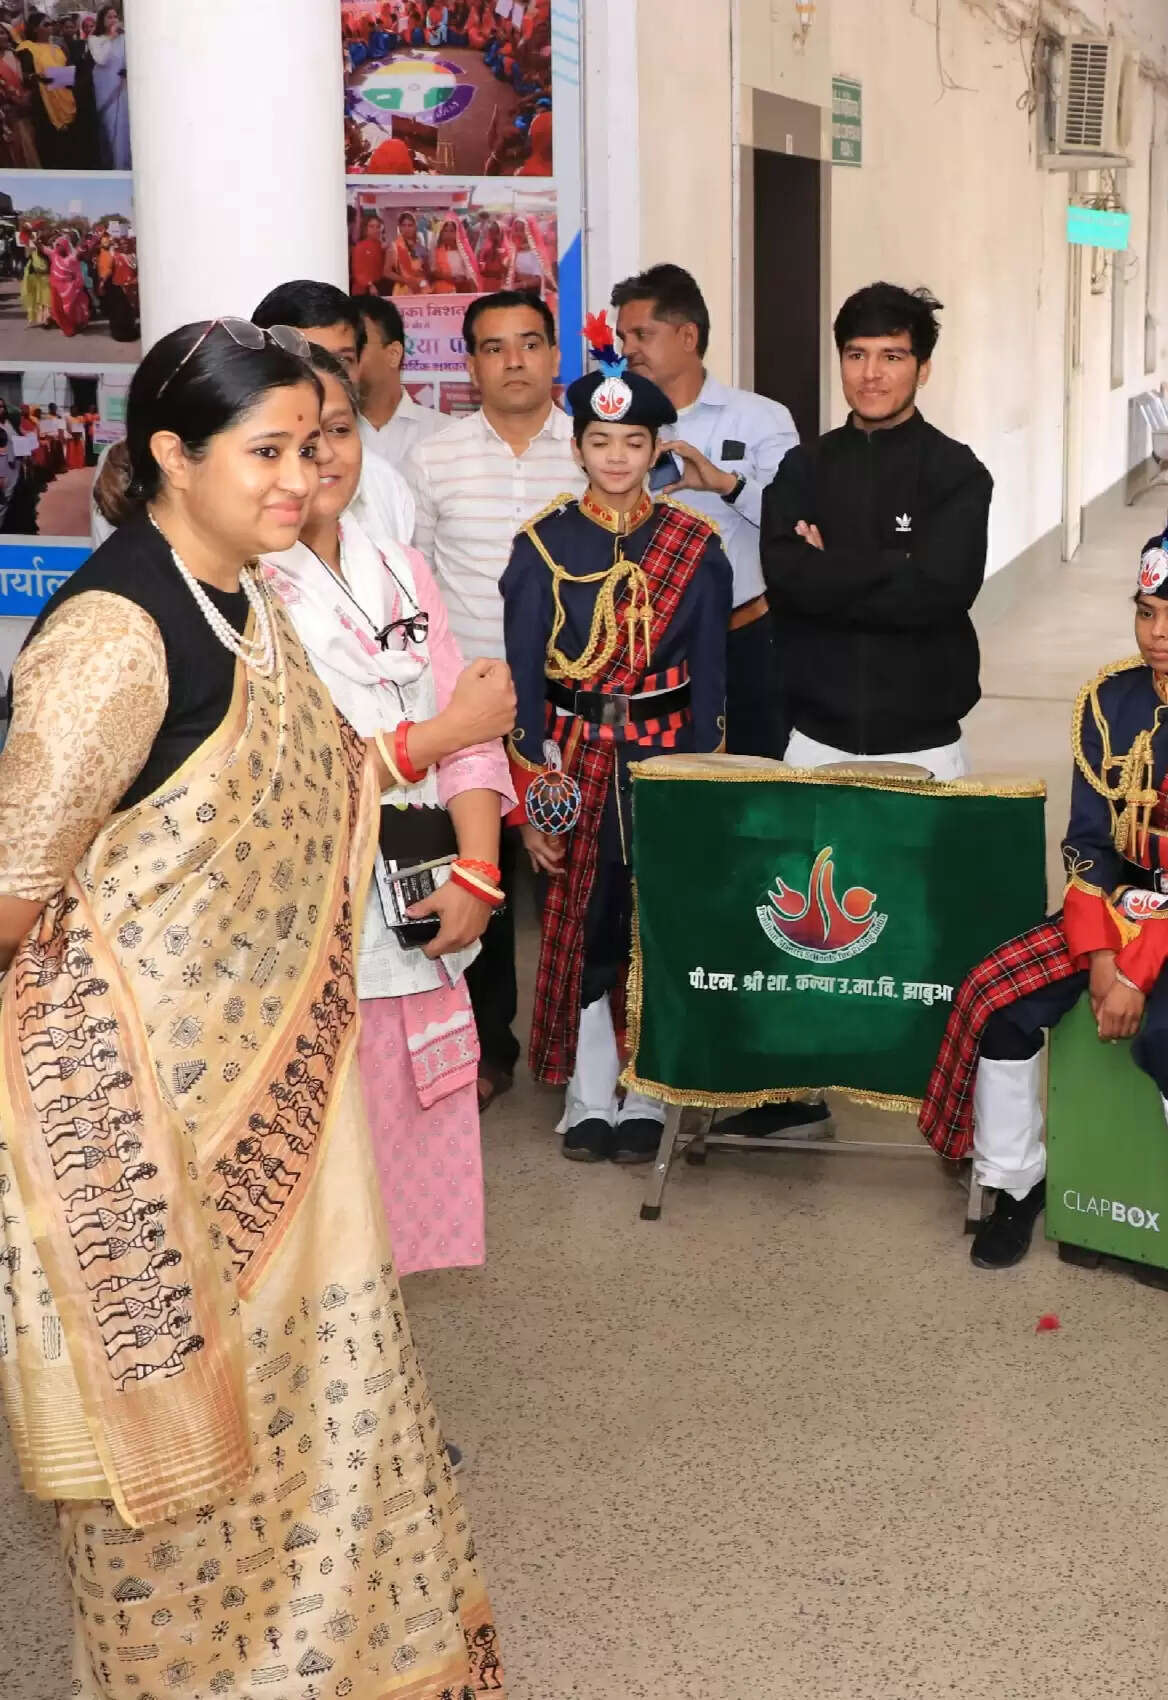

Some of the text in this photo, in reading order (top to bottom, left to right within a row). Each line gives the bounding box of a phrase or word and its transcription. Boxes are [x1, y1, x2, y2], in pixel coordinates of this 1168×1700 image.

[688, 966, 738, 991] पी.एम.
[795, 974, 835, 993] कन्या
[837, 976, 898, 998] उ.मा.वि.
[902, 982, 954, 1005] झाबुआ
[1063, 1190, 1160, 1232] CLAPBOX
